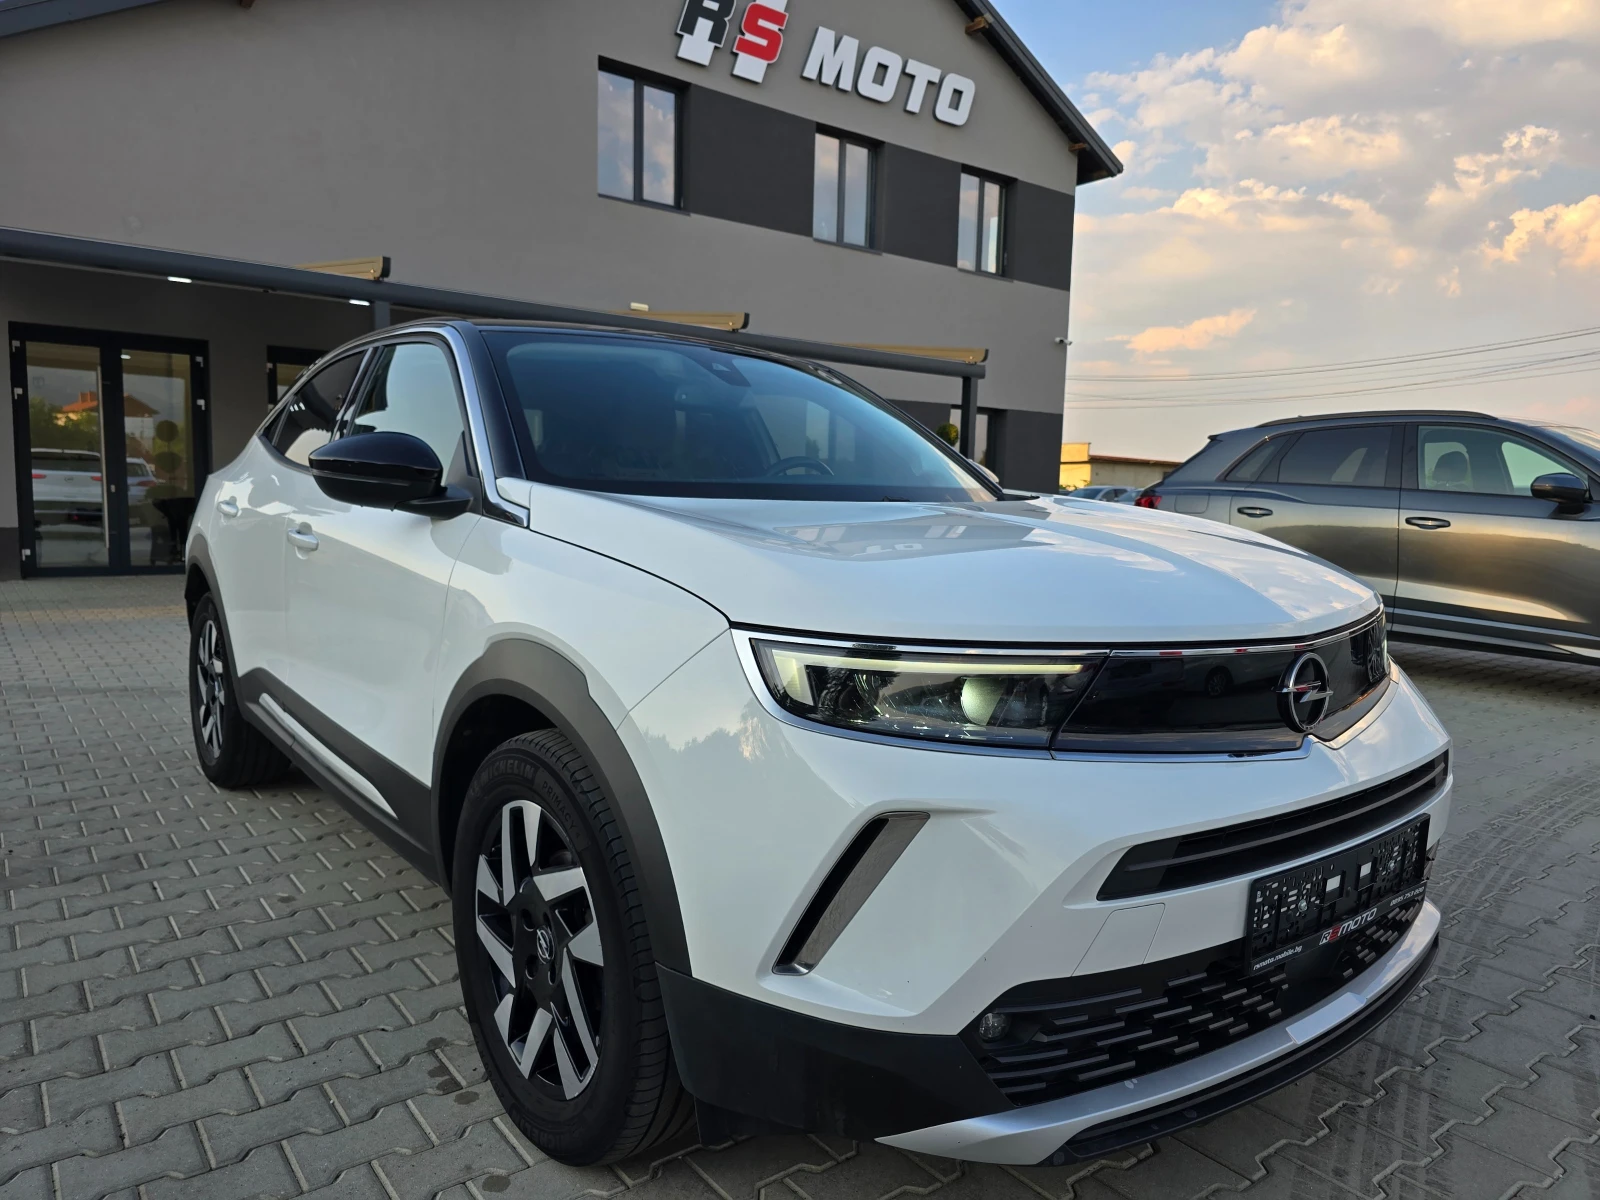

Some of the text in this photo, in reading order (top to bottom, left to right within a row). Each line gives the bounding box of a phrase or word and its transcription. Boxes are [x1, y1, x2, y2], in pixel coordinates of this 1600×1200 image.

[676, 0, 976, 126] RS MOTO
[480, 759, 535, 787] MICHELIN
[542, 781, 578, 831] PRIMACY
